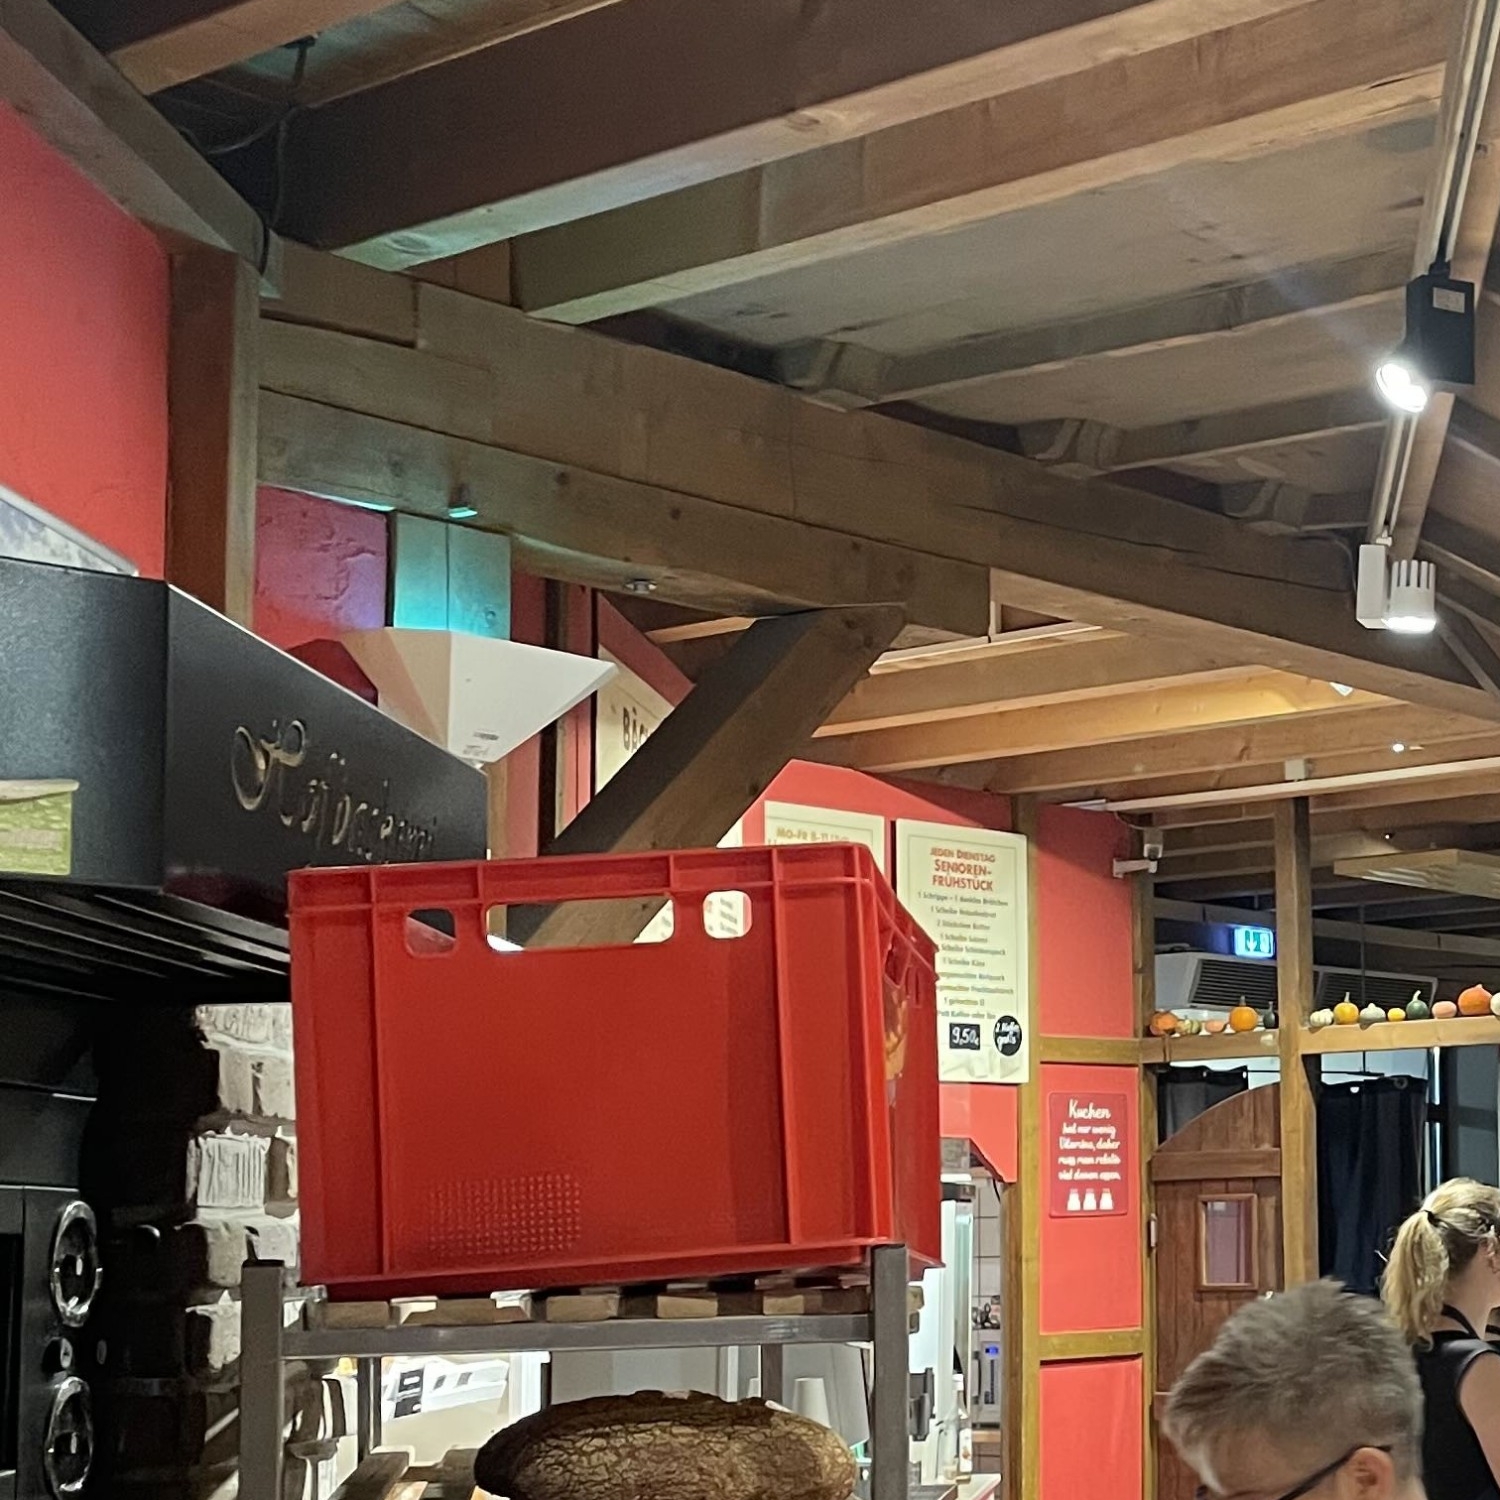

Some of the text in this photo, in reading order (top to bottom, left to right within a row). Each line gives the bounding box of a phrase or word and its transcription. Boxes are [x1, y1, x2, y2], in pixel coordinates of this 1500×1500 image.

[930, 847, 996, 863] JEDEN DIENSTAG
[934, 859, 992, 876] SENIOREN-
[932, 873, 994, 891] FRÜHSTÜCK
[1069, 1098, 1111, 1119] Kuchen
[1091, 1125, 1116, 1139] wenig
[1096, 1137, 1121, 1149] daher
